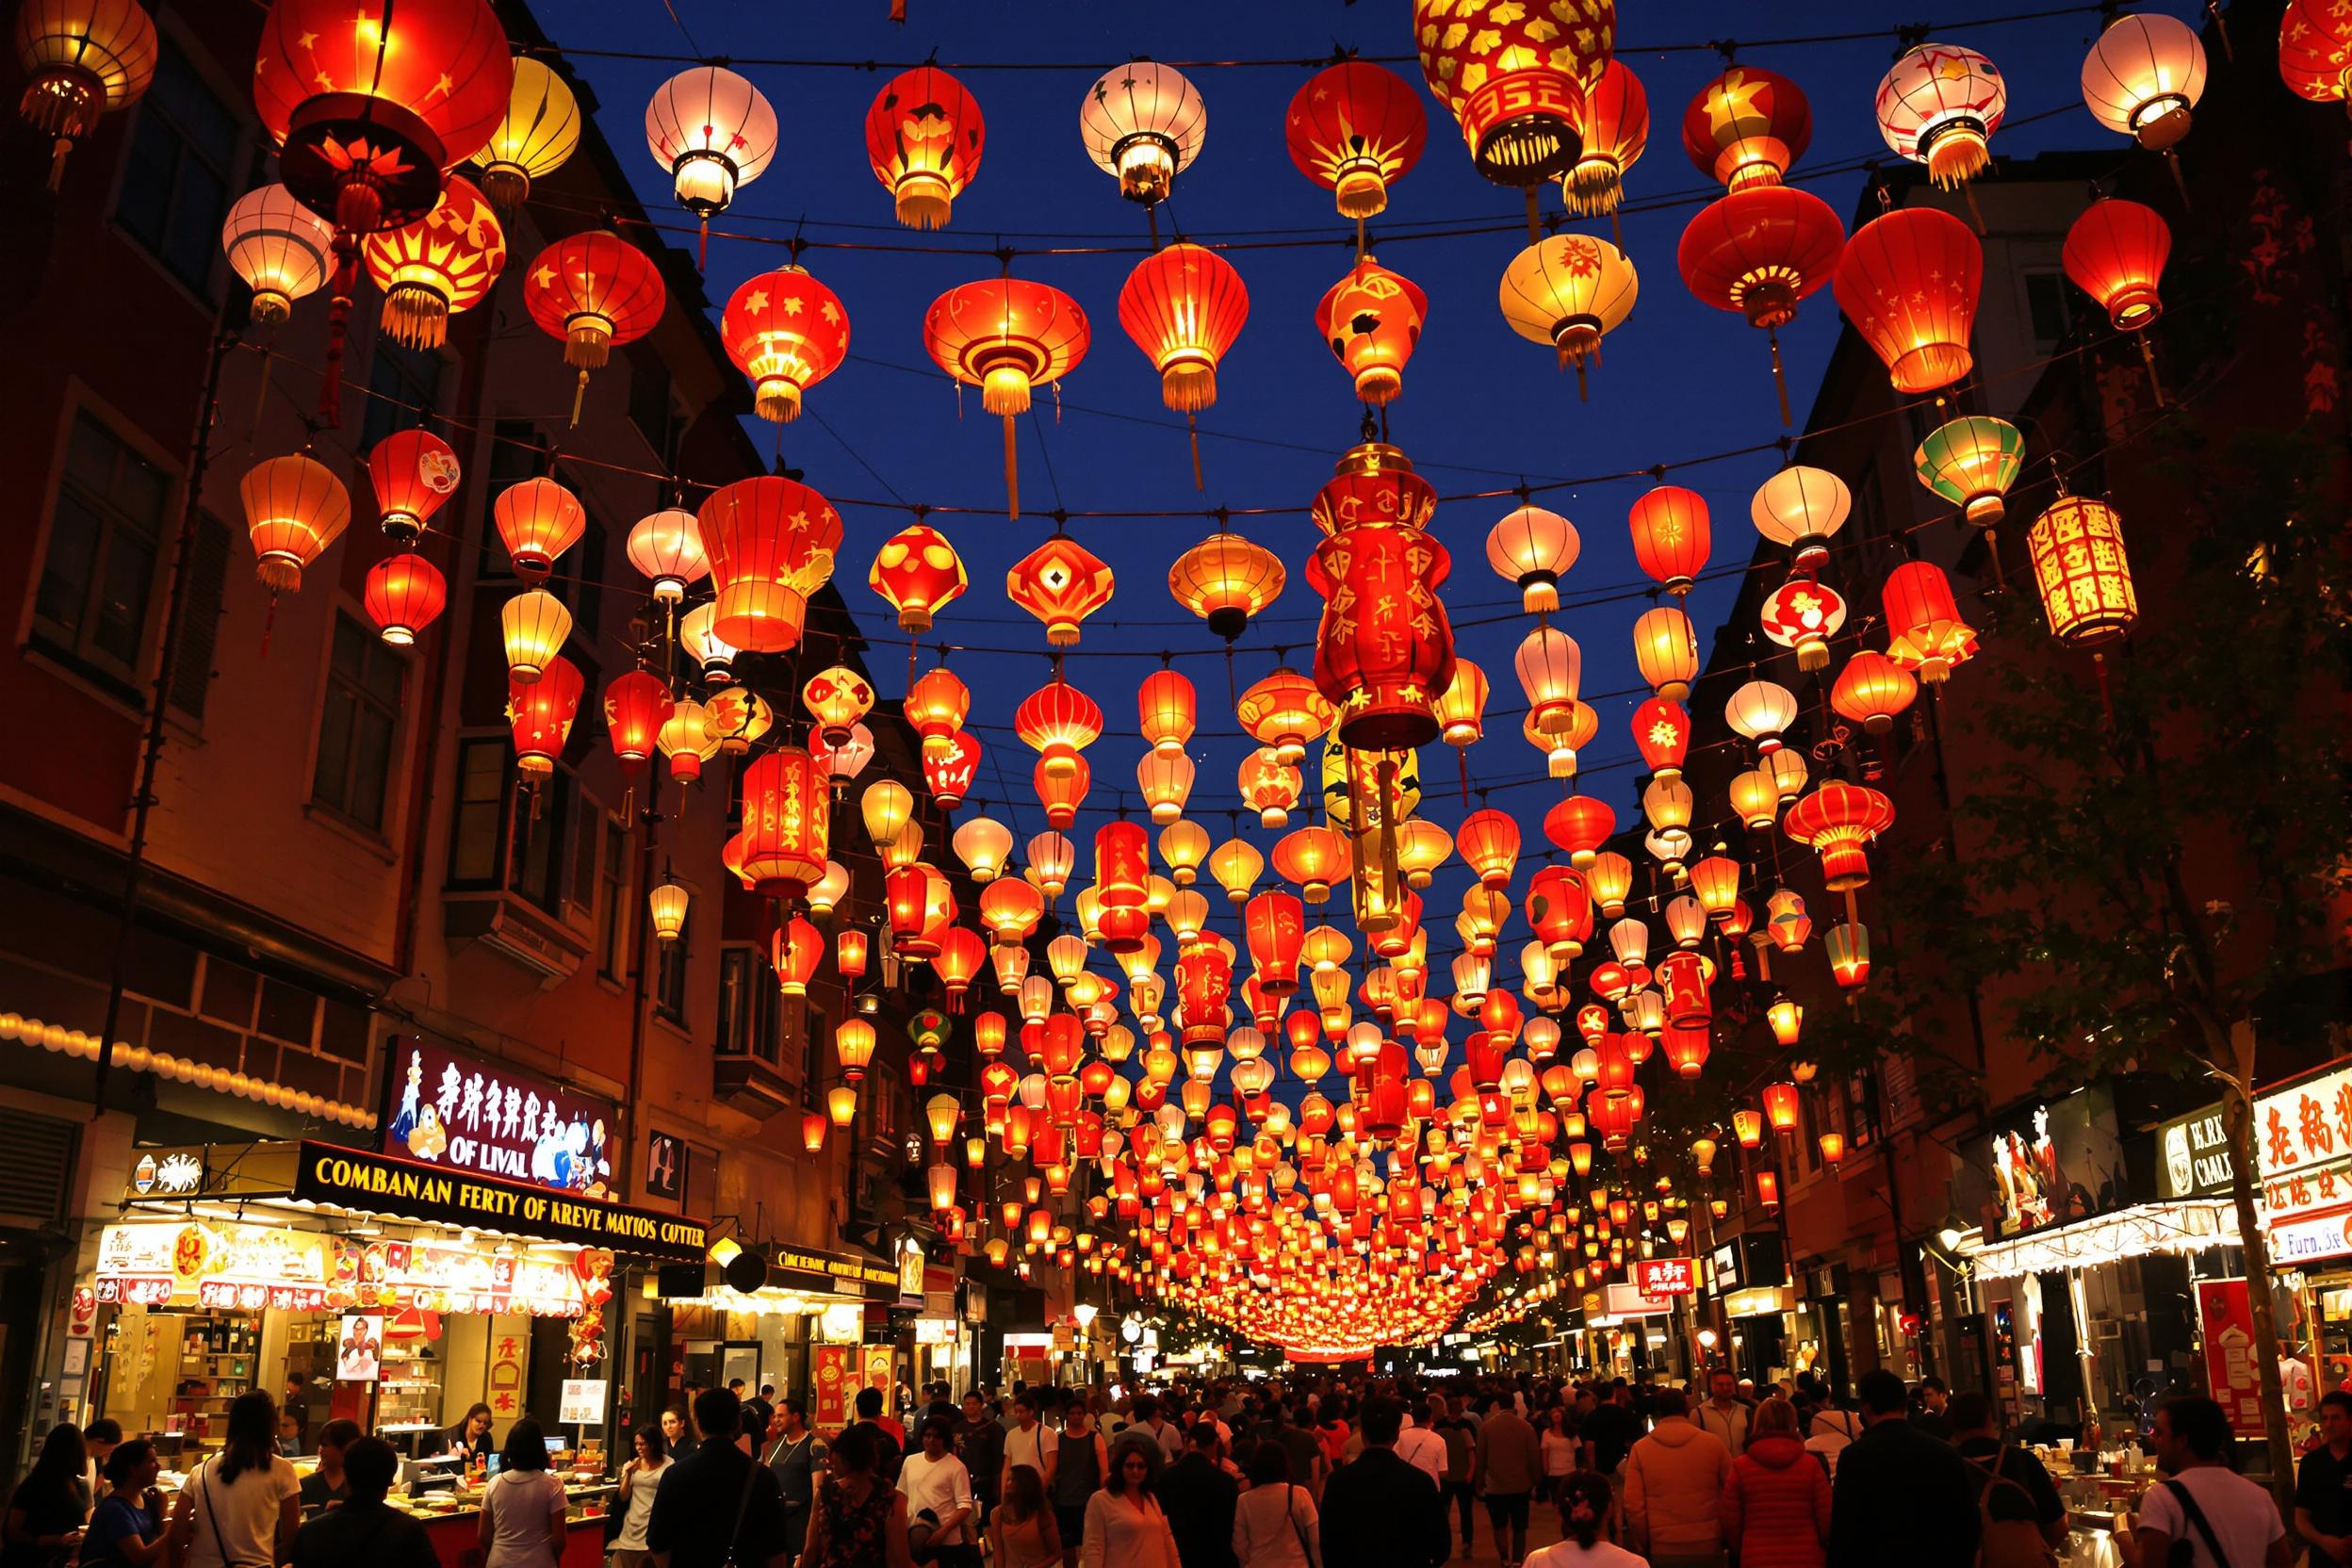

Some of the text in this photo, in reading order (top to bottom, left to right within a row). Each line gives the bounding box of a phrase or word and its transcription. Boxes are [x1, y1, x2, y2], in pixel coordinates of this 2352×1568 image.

[449, 1136, 529, 1178] OF LIVAL
[459, 1184, 520, 1216] FERTY
[524, 1197, 547, 1221] OF
